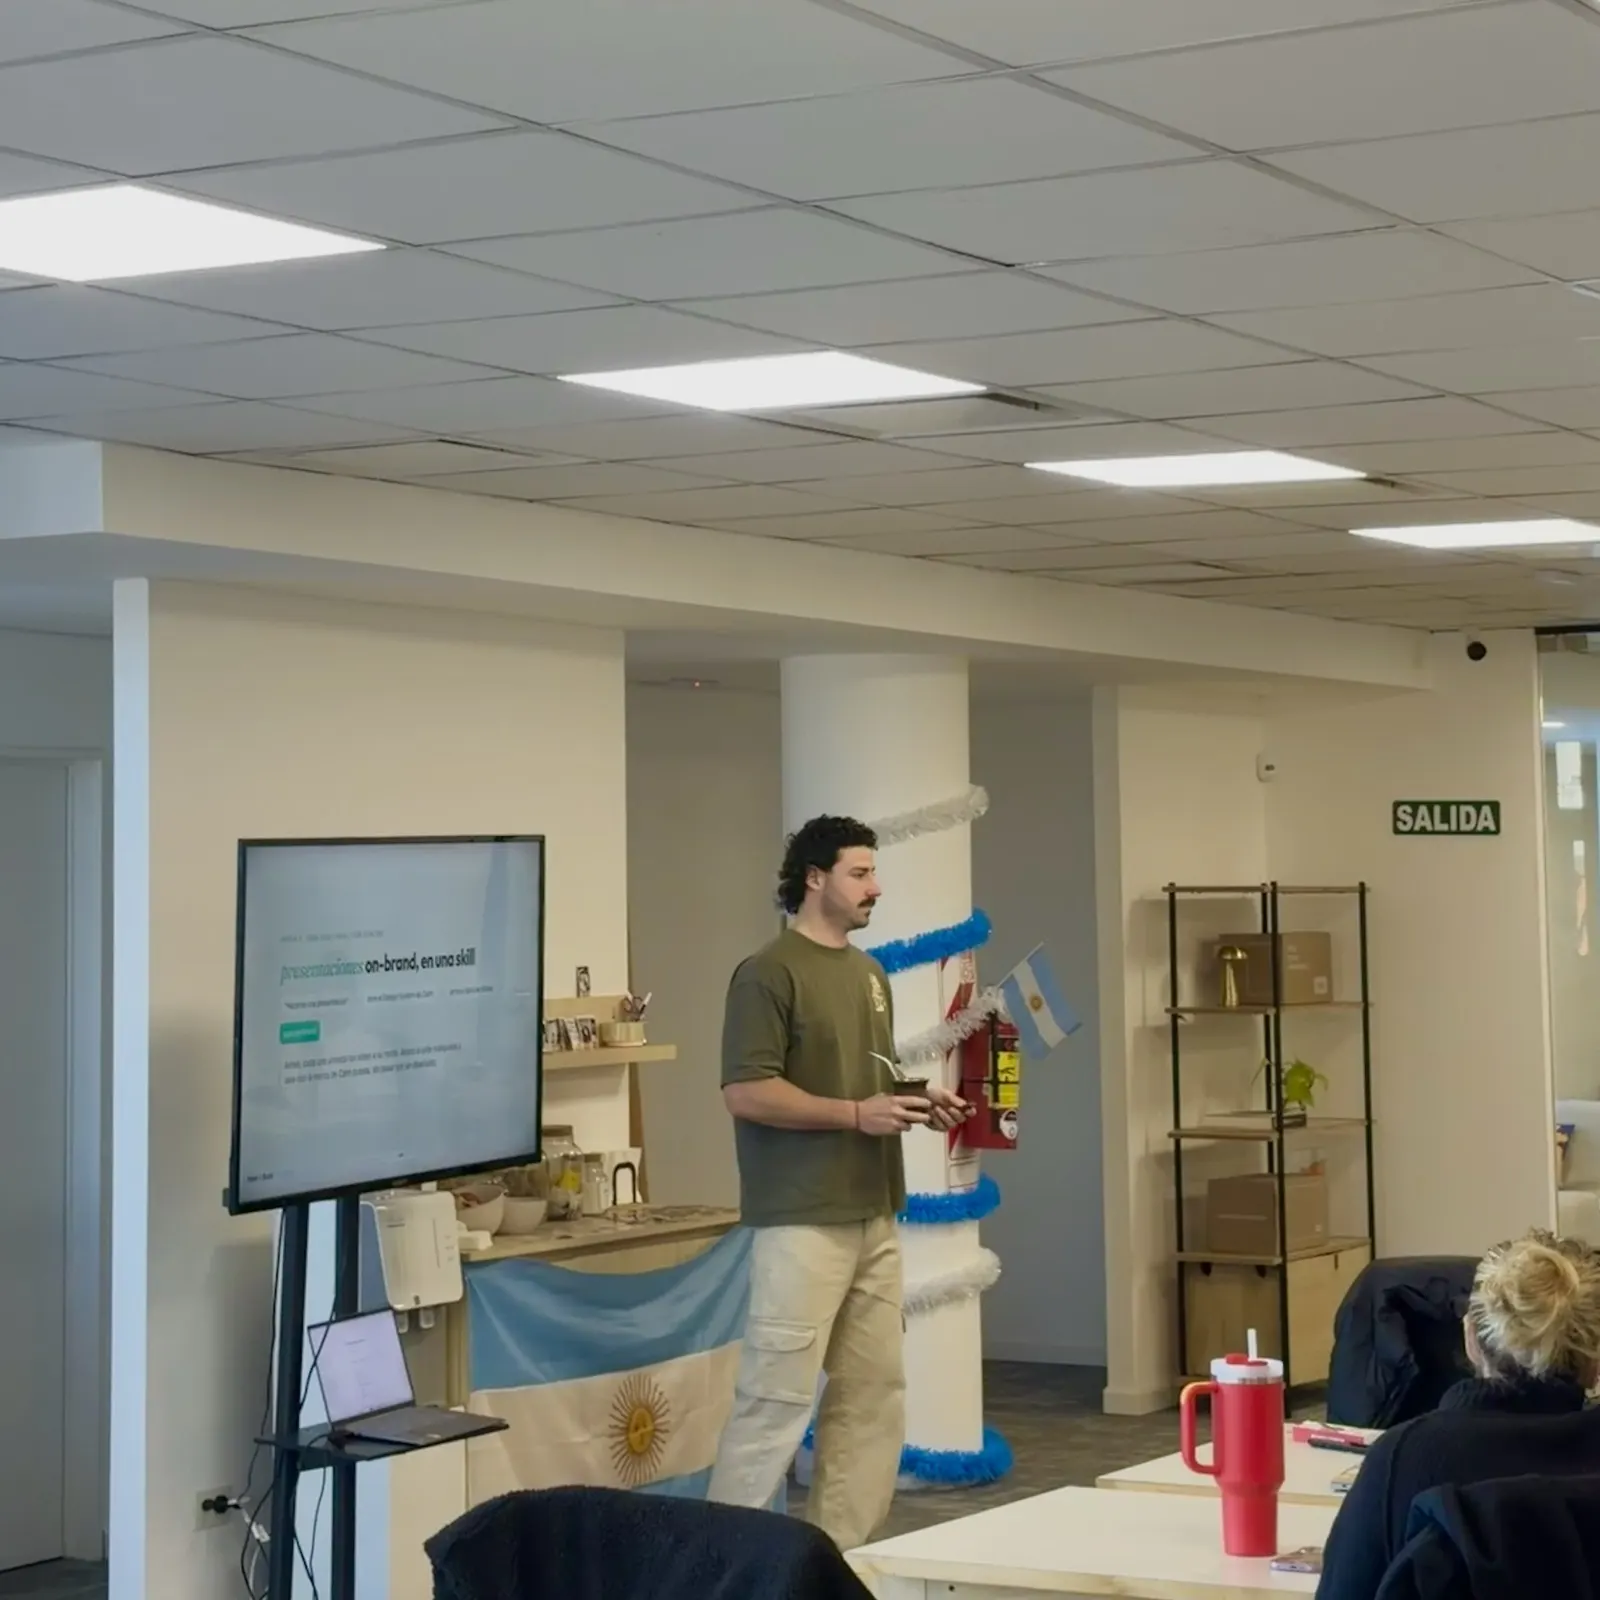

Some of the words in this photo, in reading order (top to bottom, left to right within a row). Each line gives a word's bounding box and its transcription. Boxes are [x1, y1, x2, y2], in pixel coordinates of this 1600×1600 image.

[1396, 804, 1497, 832] SALIDA
[365, 952, 419, 973] on-brand,
[421, 956, 434, 969] en
[435, 954, 454, 968] una
[456, 947, 476, 967] skill
